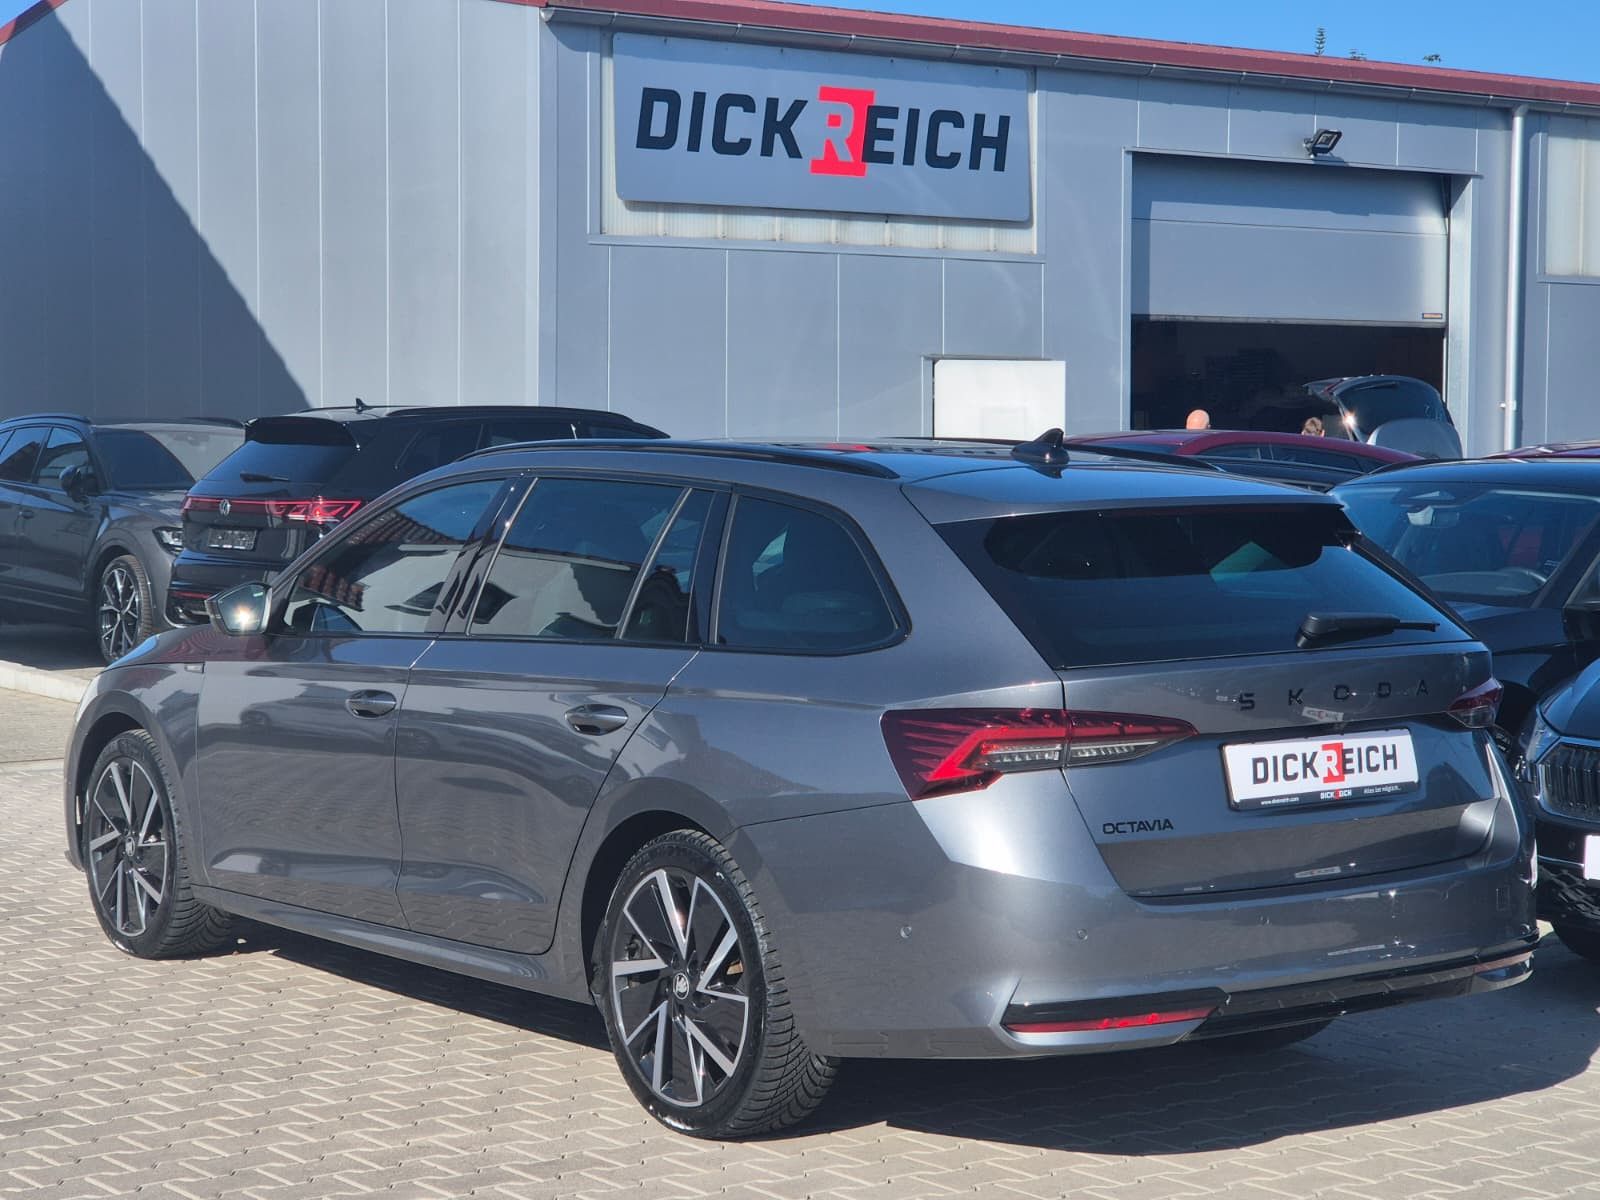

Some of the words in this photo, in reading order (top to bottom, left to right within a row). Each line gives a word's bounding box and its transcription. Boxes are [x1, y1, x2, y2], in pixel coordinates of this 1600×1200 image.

[636, 86, 1011, 177] DICKREICH
[1252, 742, 1398, 784] DICKREICH
[1320, 788, 1352, 800] DICKEICH
[1102, 818, 1174, 834] OCTAVIA
